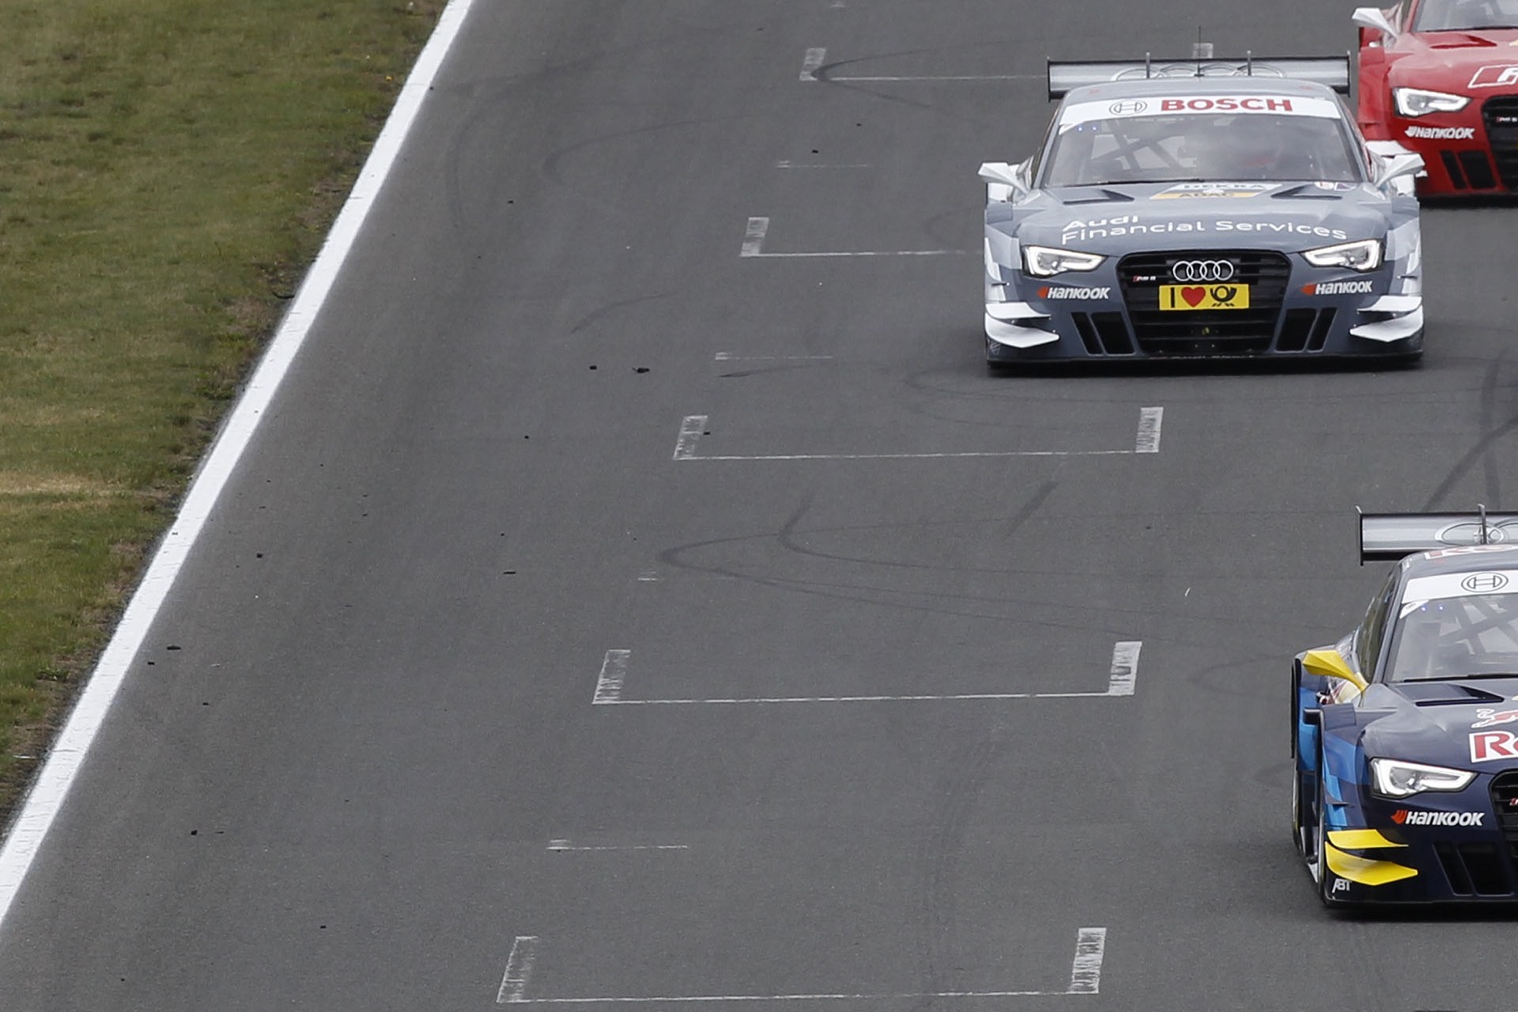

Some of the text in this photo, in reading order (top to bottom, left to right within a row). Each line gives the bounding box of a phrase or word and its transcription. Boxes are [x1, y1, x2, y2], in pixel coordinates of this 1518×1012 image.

[1161, 98, 1293, 113] BOSCH
[1061, 215, 1139, 232] Audi
[1061, 219, 1348, 245] Financial Services
